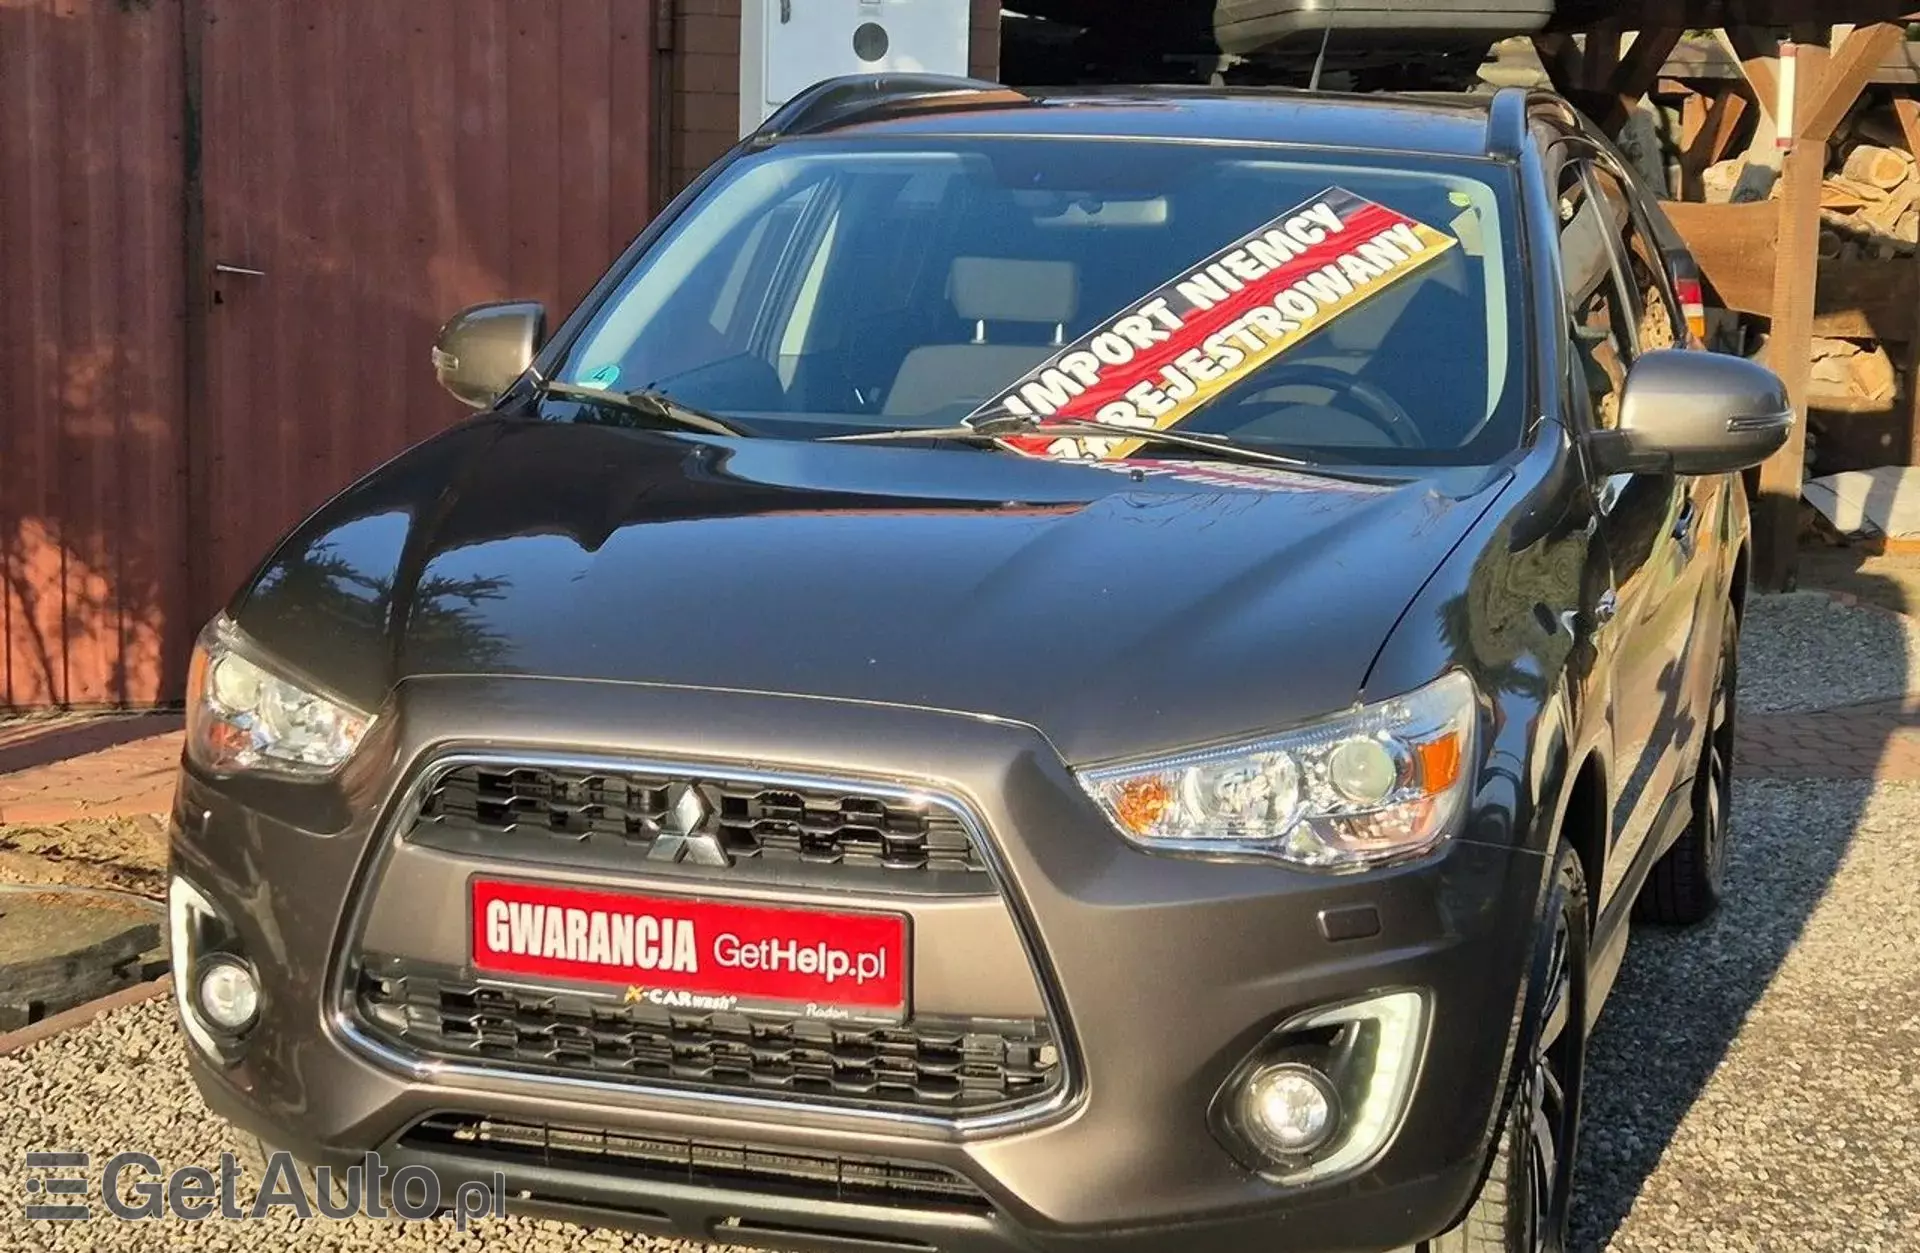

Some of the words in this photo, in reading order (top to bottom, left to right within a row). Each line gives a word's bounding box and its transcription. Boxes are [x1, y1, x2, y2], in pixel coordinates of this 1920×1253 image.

[1003, 299, 1184, 419] IMPORT
[1177, 203, 1345, 311] NIEMCY
[486, 898, 698, 973] GWARANCJA
[713, 933, 886, 984] GetHelp.pl
